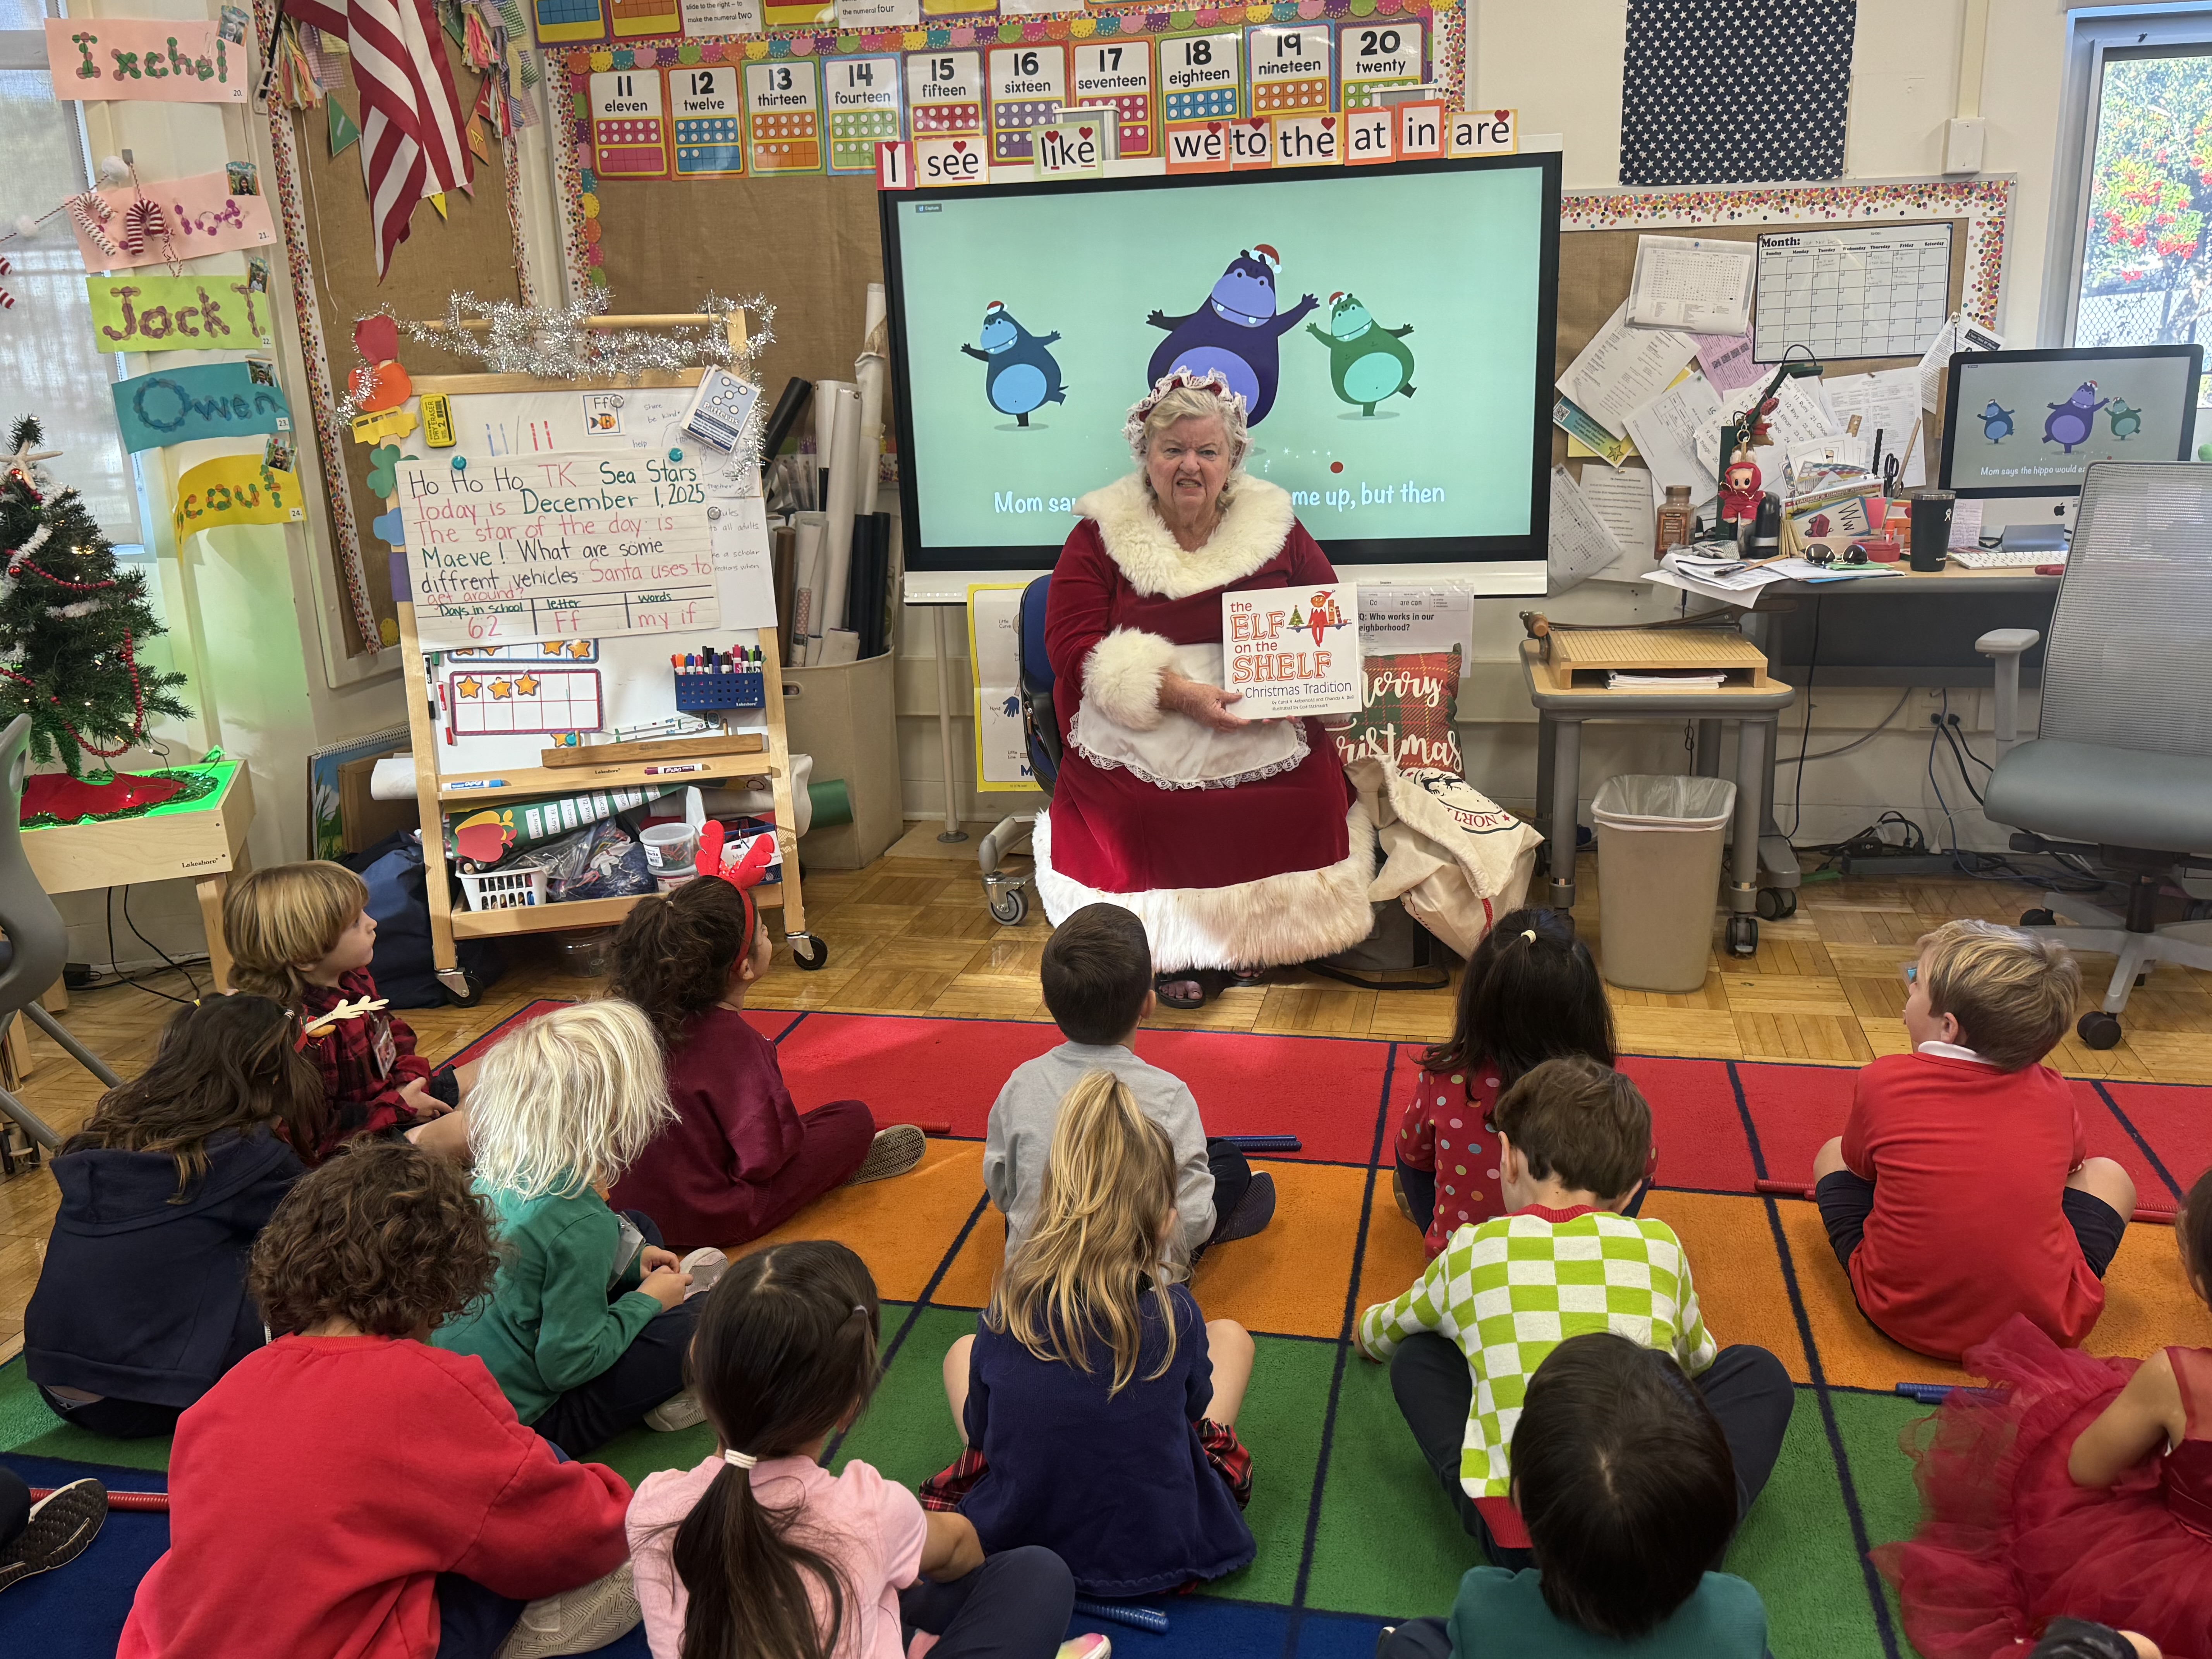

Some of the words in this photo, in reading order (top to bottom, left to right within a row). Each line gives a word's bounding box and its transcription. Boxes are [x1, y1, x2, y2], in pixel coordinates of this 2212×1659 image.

[878, 4, 894, 13] four
[1185, 40, 1212, 66] 18
[1276, 33, 1302, 58] 19
[1360, 30, 1401, 57] 20
[72, 32, 227, 82] Ixchel
[1013, 52, 1039, 77] 16
[1099, 47, 1123, 72] 17
[1258, 59, 1321, 76] nineteen
[1355, 59, 1406, 75] twenty
[768, 68, 792, 91] 13
[849, 64, 874, 88] 14
[931, 58, 954, 81] 15
[1169, 67, 1230, 87] eighteen
[617, 75, 633, 96] 11
[691, 72, 714, 95] 12
[922, 85, 966, 98] fifteen
[1005, 81, 1051, 94] sixteen
[1078, 74, 1147, 90] seventeen
[605, 100, 648, 112] eleven
[684, 98, 725, 112] twelve
[758, 93, 807, 107] thirteen
[835, 91, 890, 105] fourteen
[1232, 129, 1265, 155] to
[1280, 125, 1335, 157] the
[1355, 122, 1386, 150] at
[1408, 117, 1436, 146] in
[1456, 121, 1509, 145] are
[1041, 136, 1095, 167] like
[1174, 133, 1221, 157] we
[928, 152, 979, 177] see
[1762, 237, 1800, 247] Month:
[102, 286, 230, 341] Jack
[133, 377, 283, 433] Owen
[428, 401, 437, 425] ERASER
[594, 397, 608, 409] Ff
[703, 401, 740, 425] Patterns
[632, 439, 647, 448] help
[409, 470, 438, 498] Ho
[451, 470, 483, 493] Ho
[494, 467, 524, 492] Ho
[538, 462, 577, 488] TK
[599, 461, 636, 484] Sea
[646, 459, 697, 483] Stars
[1981, 467, 1999, 476] Mom
[2001, 468, 2018, 477] says
[2021, 466, 2032, 474] the
[2033, 466, 2053, 476] hippo
[2055, 465, 2076, 473] would
[994, 491, 1042, 513] Mom
[1326, 488, 1355, 512] up,
[1361, 482, 1395, 505] but
[1400, 480, 1445, 503] then
[1826, 489, 1849, 498] CHOICE
[412, 495, 477, 525] Today
[489, 501, 506, 515] is
[520, 488, 639, 514] December
[414, 520, 459, 546] The
[476, 519, 516, 542] star
[525, 515, 546, 539] of
[559, 515, 595, 535] the
[609, 512, 641, 538] day
[658, 516, 673, 531] is
[738, 521, 759, 531] adults
[517, 537, 571, 562] What
[583, 544, 610, 558] are
[619, 538, 664, 555] some
[421, 568, 500, 593] diffrent
[509, 566, 578, 588] vehicles
[590, 559, 642, 583] Santa
[651, 564, 688, 579] uses
[695, 554, 712, 575] to
[428, 591, 453, 611] get
[464, 582, 524, 602] around?
[547, 598, 581, 610] letter
[638, 591, 672, 603] words
[1230, 601, 1252, 613] the
[438, 604, 470, 620] Days
[472, 605, 484, 615] in
[555, 609, 581, 633] Ff
[638, 612, 668, 630] my
[681, 601, 697, 624] if
[468, 615, 502, 639] 62
[1230, 610, 1285, 642] ELF
[1359, 623, 1410, 632] eighborhood?
[1235, 644, 1251, 654] on
[1256, 641, 1278, 652] the
[1232, 651, 1332, 684] SHELF
[1245, 685, 1300, 698] Christmas
[1303, 681, 1351, 694] Tradition
[182, 859, 217, 868] Lakeshore
